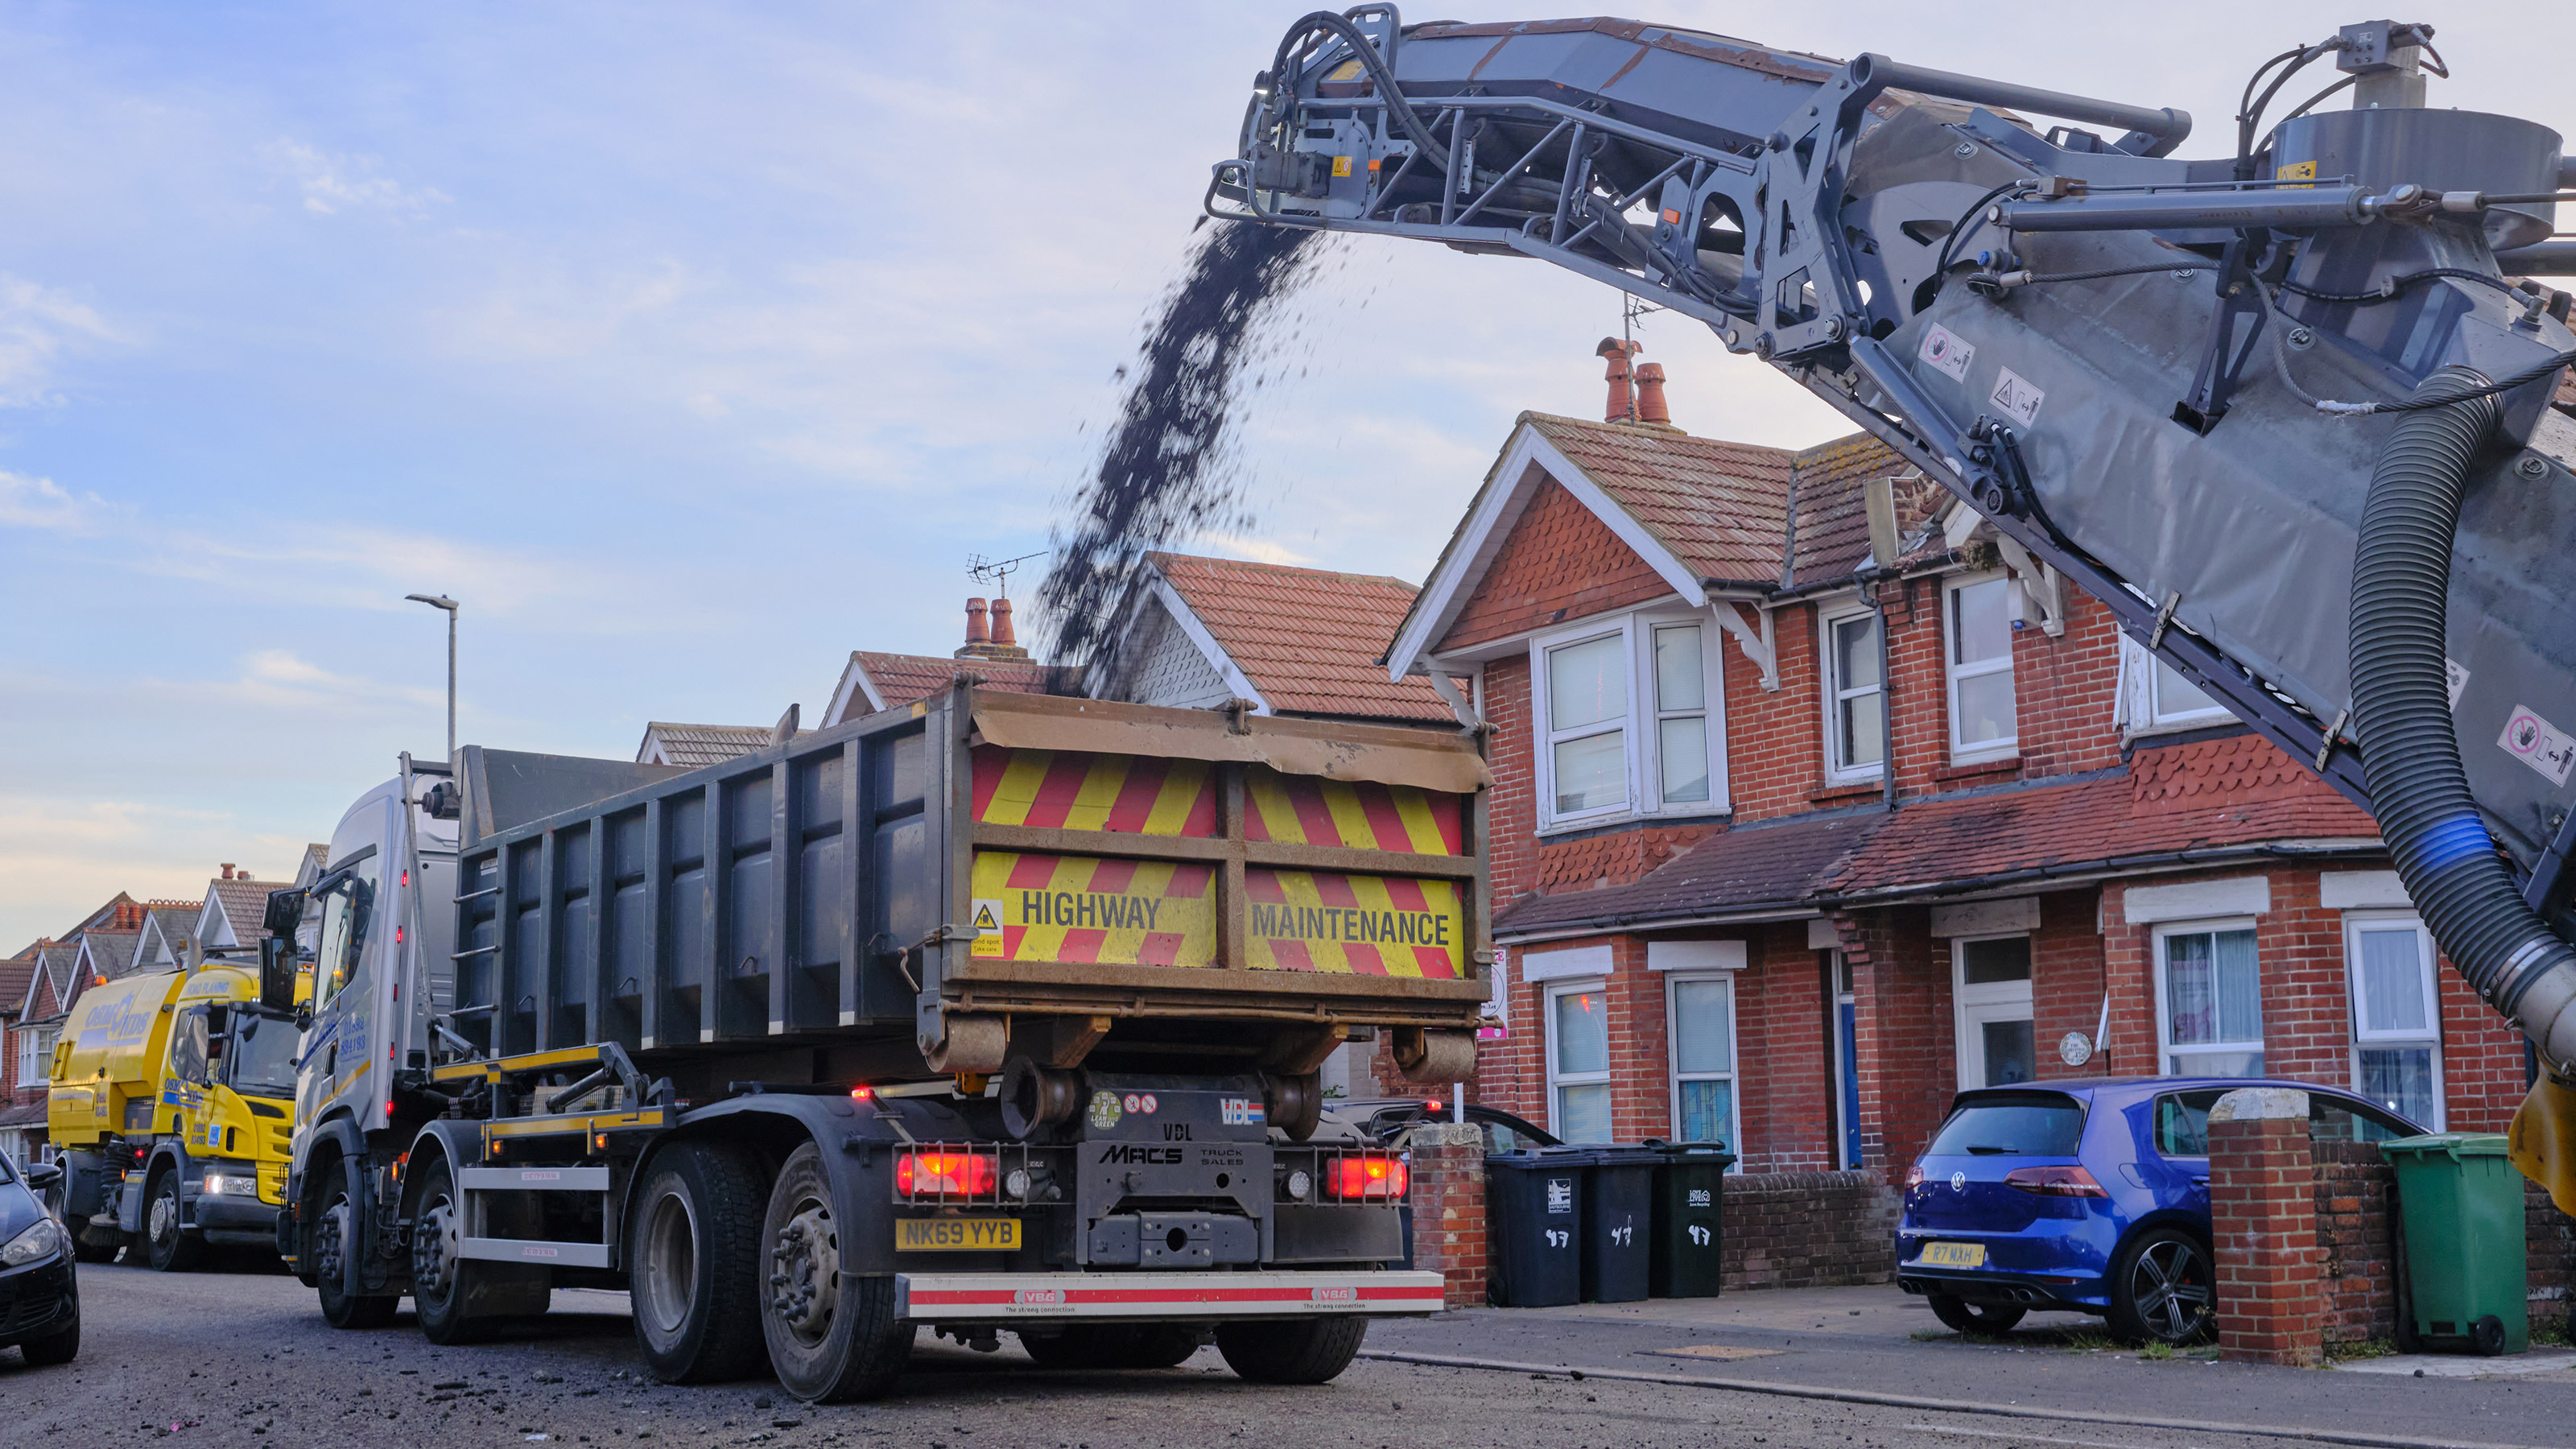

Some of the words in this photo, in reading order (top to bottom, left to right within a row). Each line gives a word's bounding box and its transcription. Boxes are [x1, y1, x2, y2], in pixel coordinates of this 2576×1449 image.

[1022, 890, 1162, 930] HIGHWAY
[1252, 903, 1449, 945] MAINTENANCE
[186, 983, 201, 995] ROAD
[202, 981, 229, 994] PLANING
[1220, 1098, 1253, 1125] VDL
[1163, 1123, 1193, 1141] VDL
[1098, 1145, 1183, 1164] MAC'S
[906, 1222, 964, 1245] NK69
[971, 1222, 1013, 1244] YYB
[1546, 1228, 1569, 1248] 47
[1611, 1220, 1633, 1247] 47
[1688, 1224, 1711, 1246] 47
[1933, 1246, 1948, 1261] R7
[1949, 1247, 1973, 1263] MXH
[1026, 1293, 1055, 1302] VBG
[1322, 1290, 1348, 1298] VBG
